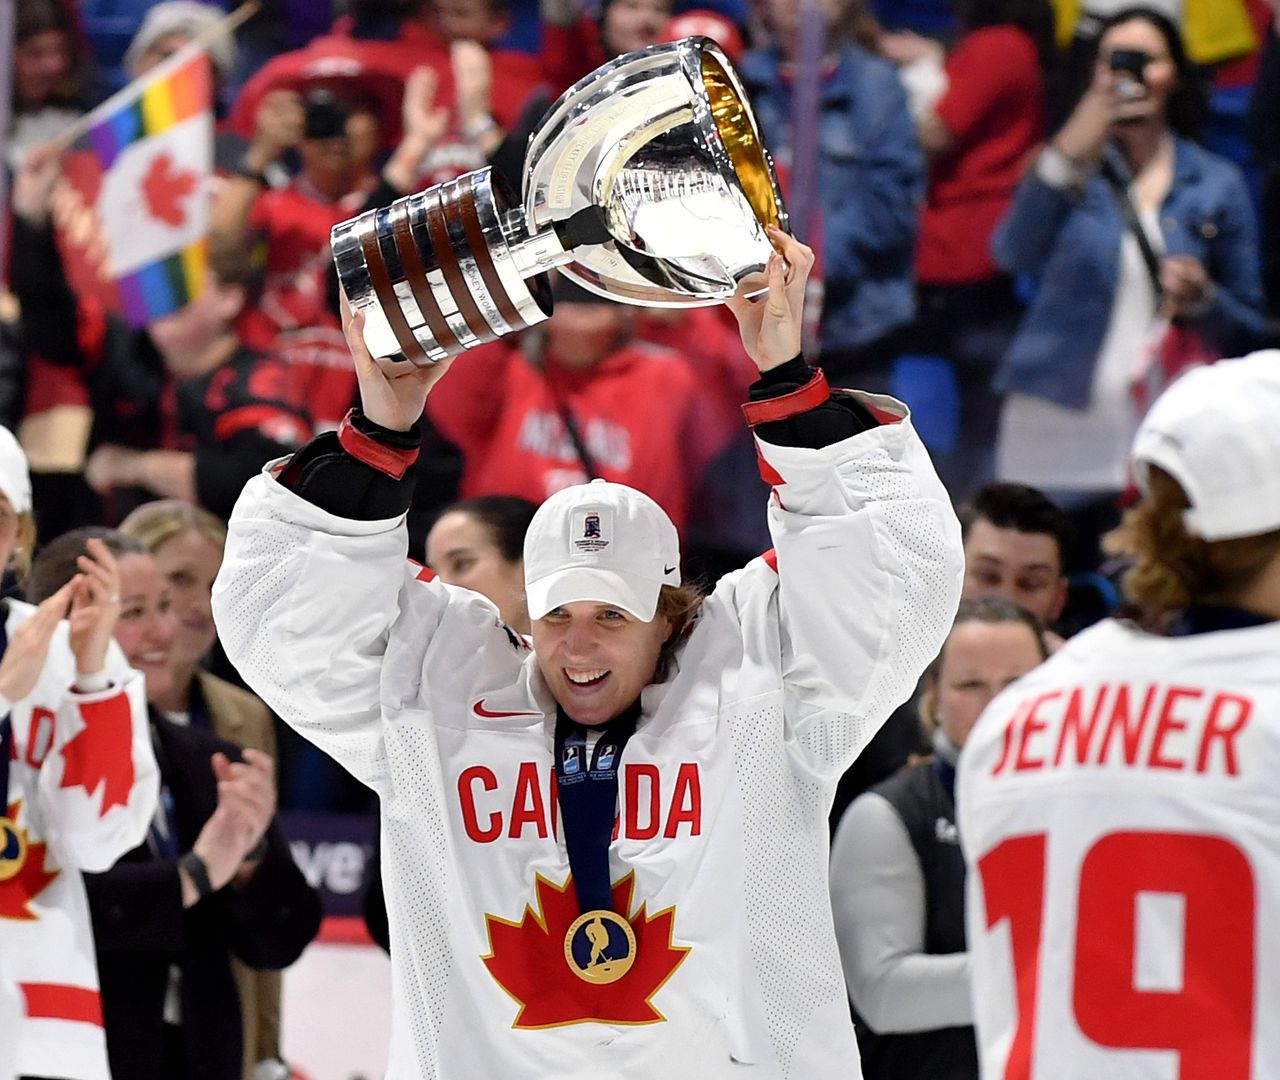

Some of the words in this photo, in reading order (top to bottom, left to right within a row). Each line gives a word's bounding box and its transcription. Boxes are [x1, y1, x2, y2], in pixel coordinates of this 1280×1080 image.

[991, 683, 1254, 778] JENNER
[456, 761, 703, 844] CADA
[289, 840, 365, 895] ve
